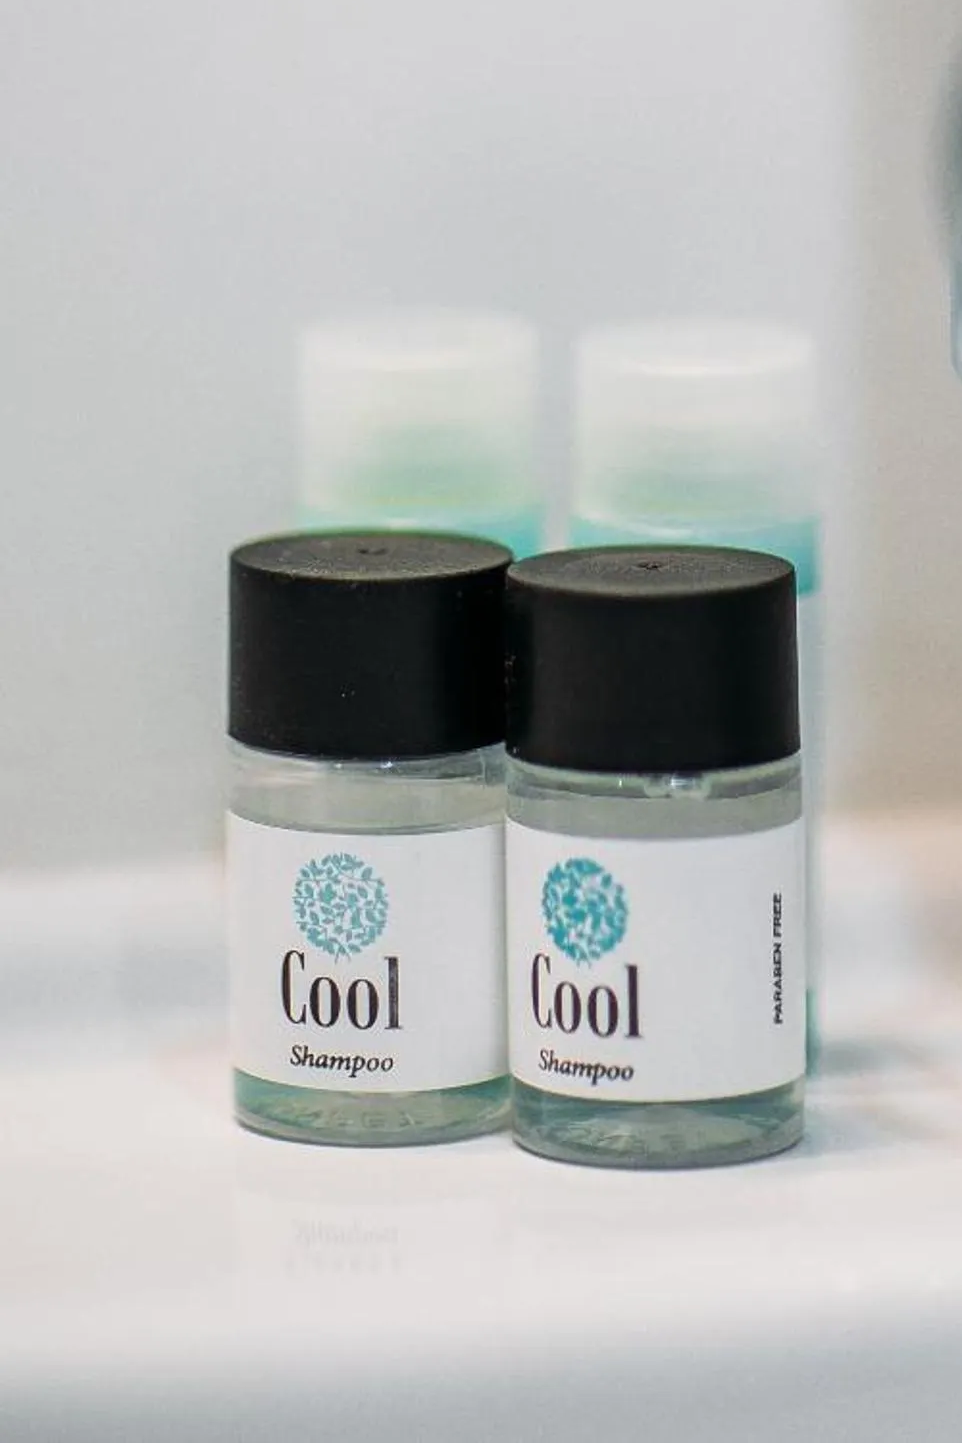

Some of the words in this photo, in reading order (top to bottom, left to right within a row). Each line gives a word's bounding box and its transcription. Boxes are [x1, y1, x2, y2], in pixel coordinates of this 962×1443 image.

[772, 892, 783, 938] FREE
[281, 950, 402, 1031] Cool
[531, 953, 643, 1039] Cool
[772, 942, 783, 1025] PARABEN
[289, 1044, 394, 1079] Shampoo
[538, 1049, 635, 1087] Shampoo
